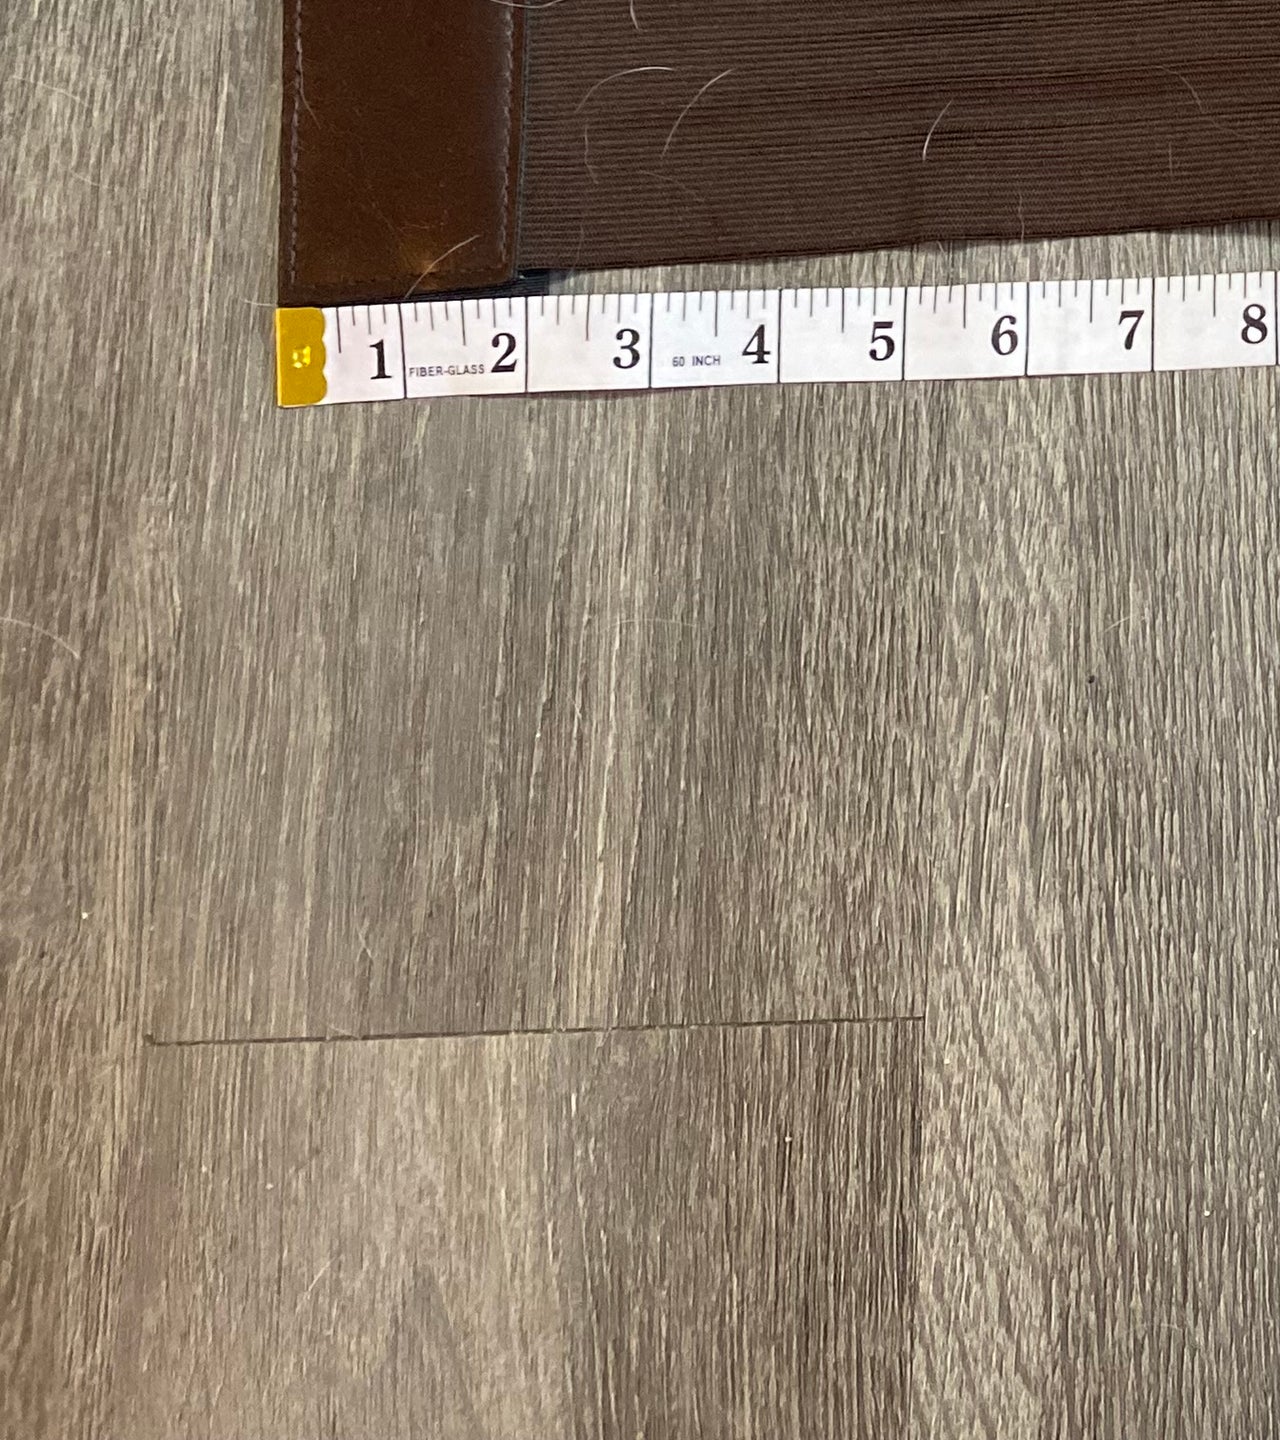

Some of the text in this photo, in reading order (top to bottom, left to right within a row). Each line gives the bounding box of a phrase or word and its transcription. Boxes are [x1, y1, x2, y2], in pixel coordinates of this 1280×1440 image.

[370, 339, 392, 380] 1
[490, 332, 518, 373] 2
[613, 328, 641, 369] 3
[742, 324, 771, 365] 4
[869, 321, 895, 361] 5
[991, 315, 1019, 356] 6
[1118, 309, 1145, 350] 7
[1241, 303, 1268, 345] 8
[672, 355, 721, 367] 60 INCH
[408, 363, 485, 378] FIBER-GLASS
